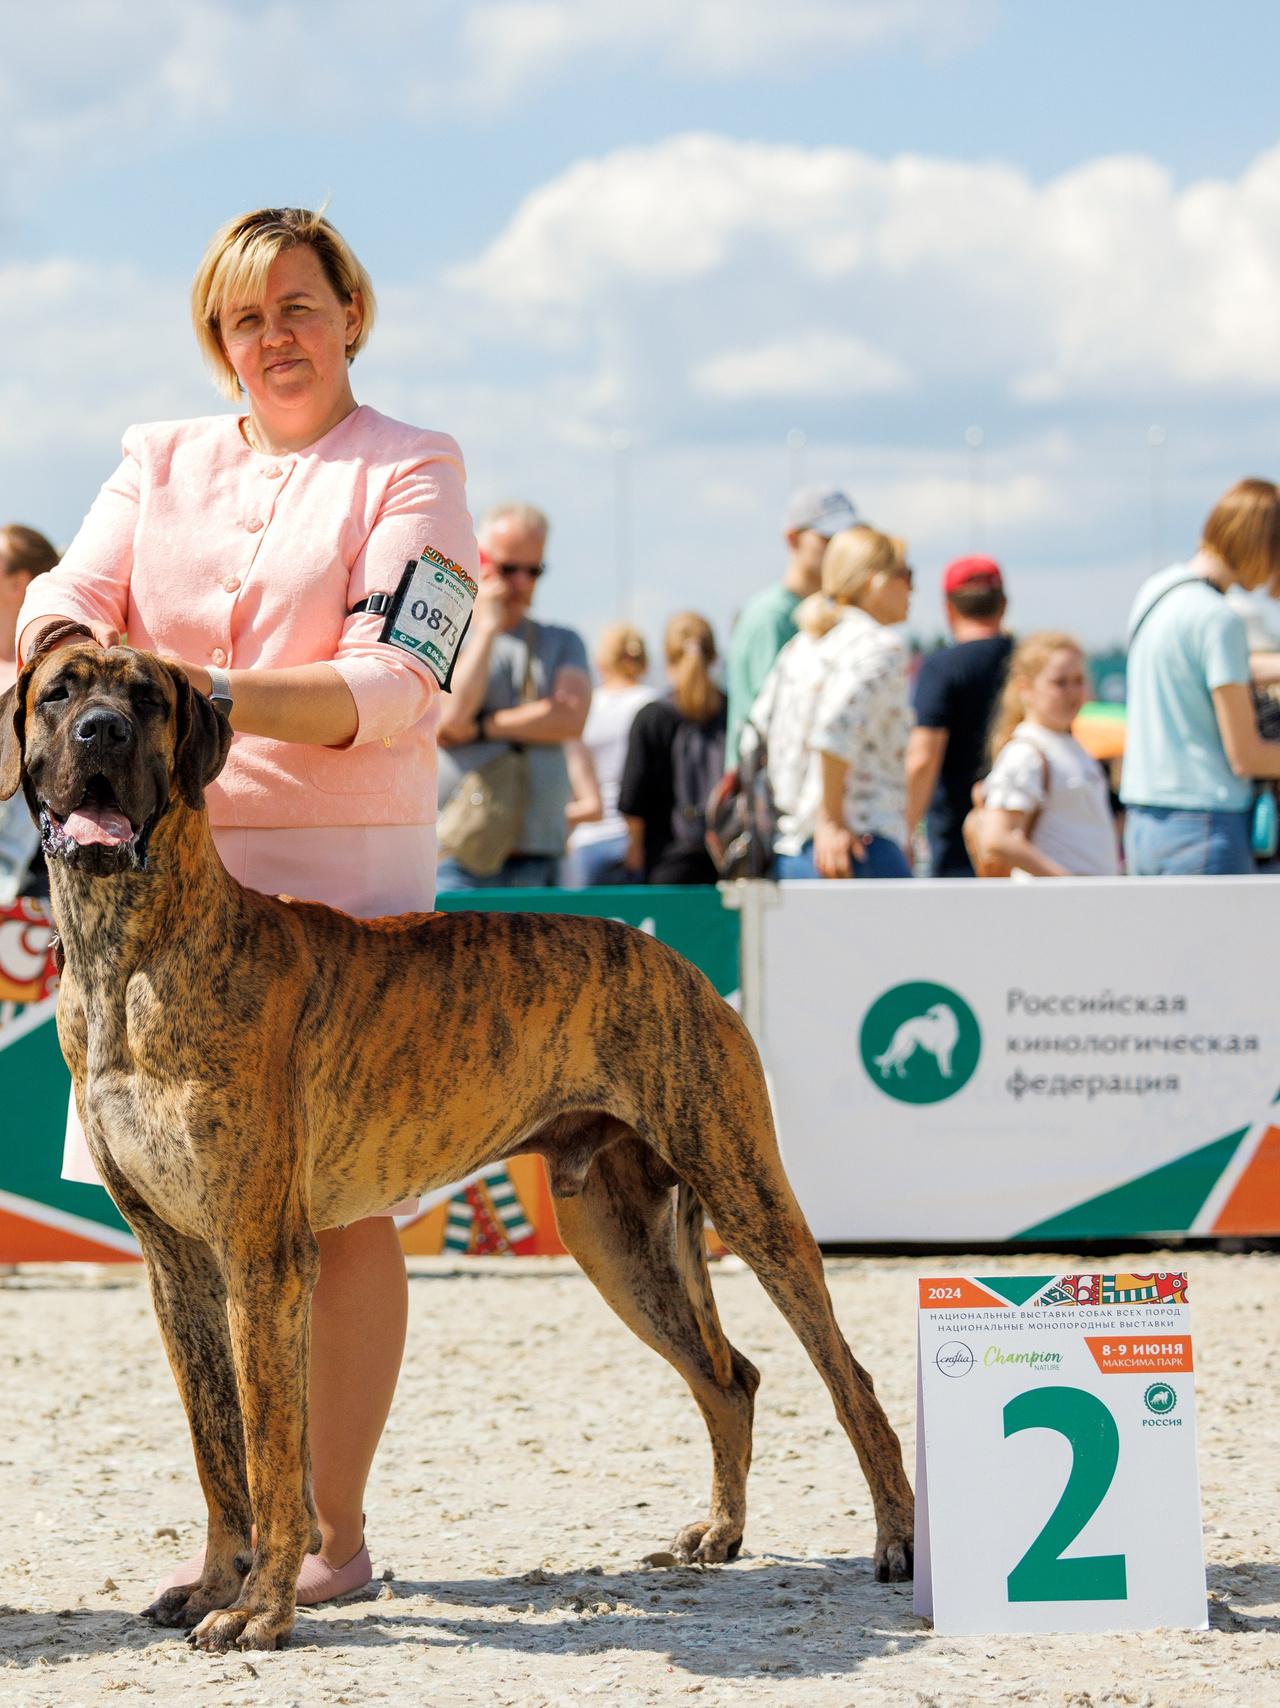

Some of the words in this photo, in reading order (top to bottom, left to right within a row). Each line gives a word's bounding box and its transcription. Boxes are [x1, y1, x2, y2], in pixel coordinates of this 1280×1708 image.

[411, 599, 459, 647] 0873
[1005, 987, 1187, 1017] Российская
[1005, 1032, 1260, 1058] кинологическая
[1004, 1065, 1181, 1100] федерация
[928, 1287, 962, 1299] 2024
[930, 1311, 1016, 1321] НАЦИОНАЛЬНЫЕ
[1020, 1310, 1075, 1319] ВЫСТАВКИ
[1079, 1309, 1113, 1318] СОБАК
[1116, 1309, 1142, 1317] ВСЕХ
[1145, 1308, 1181, 1316] ПОРОД
[937, 1323, 1024, 1332] НАЦИОНАЛЬНЫЕ
[1028, 1321, 1116, 1330] МОНОПОРОДНЫЕ
[1119, 1320, 1174, 1328] ВЫСТАВКИ
[984, 1345, 1063, 1368] Champion
[1102, 1344, 1127, 1356] 8-9
[1133, 1343, 1184, 1355] ИЮНЯ
[1102, 1359, 1155, 1367] МАКСИМА
[1157, 1358, 1184, 1366] ПАРК
[1142, 1418, 1183, 1427] РОССИЯ
[1002, 1385, 1128, 1603] 2
